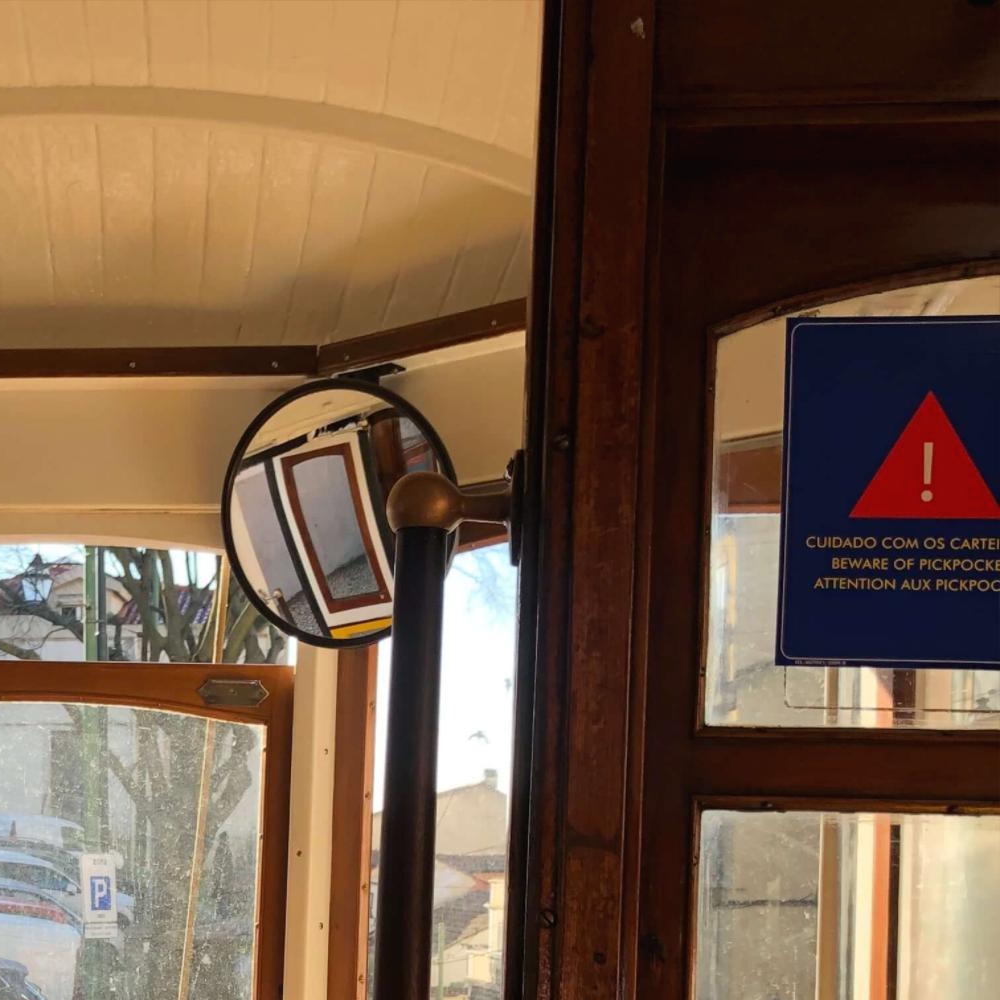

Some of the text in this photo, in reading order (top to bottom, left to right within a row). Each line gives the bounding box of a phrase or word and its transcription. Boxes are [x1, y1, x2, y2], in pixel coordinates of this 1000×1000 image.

[805, 536, 877, 549] CUIDADO
[881, 537, 919, 550] COM
[923, 537, 946, 550] OS
[831, 557, 889, 570] BEWARE
[893, 558, 915, 571] OF
[813, 577, 1000, 592] ATTENTION AUX PICKPOC
[94, 878, 108, 908] P
